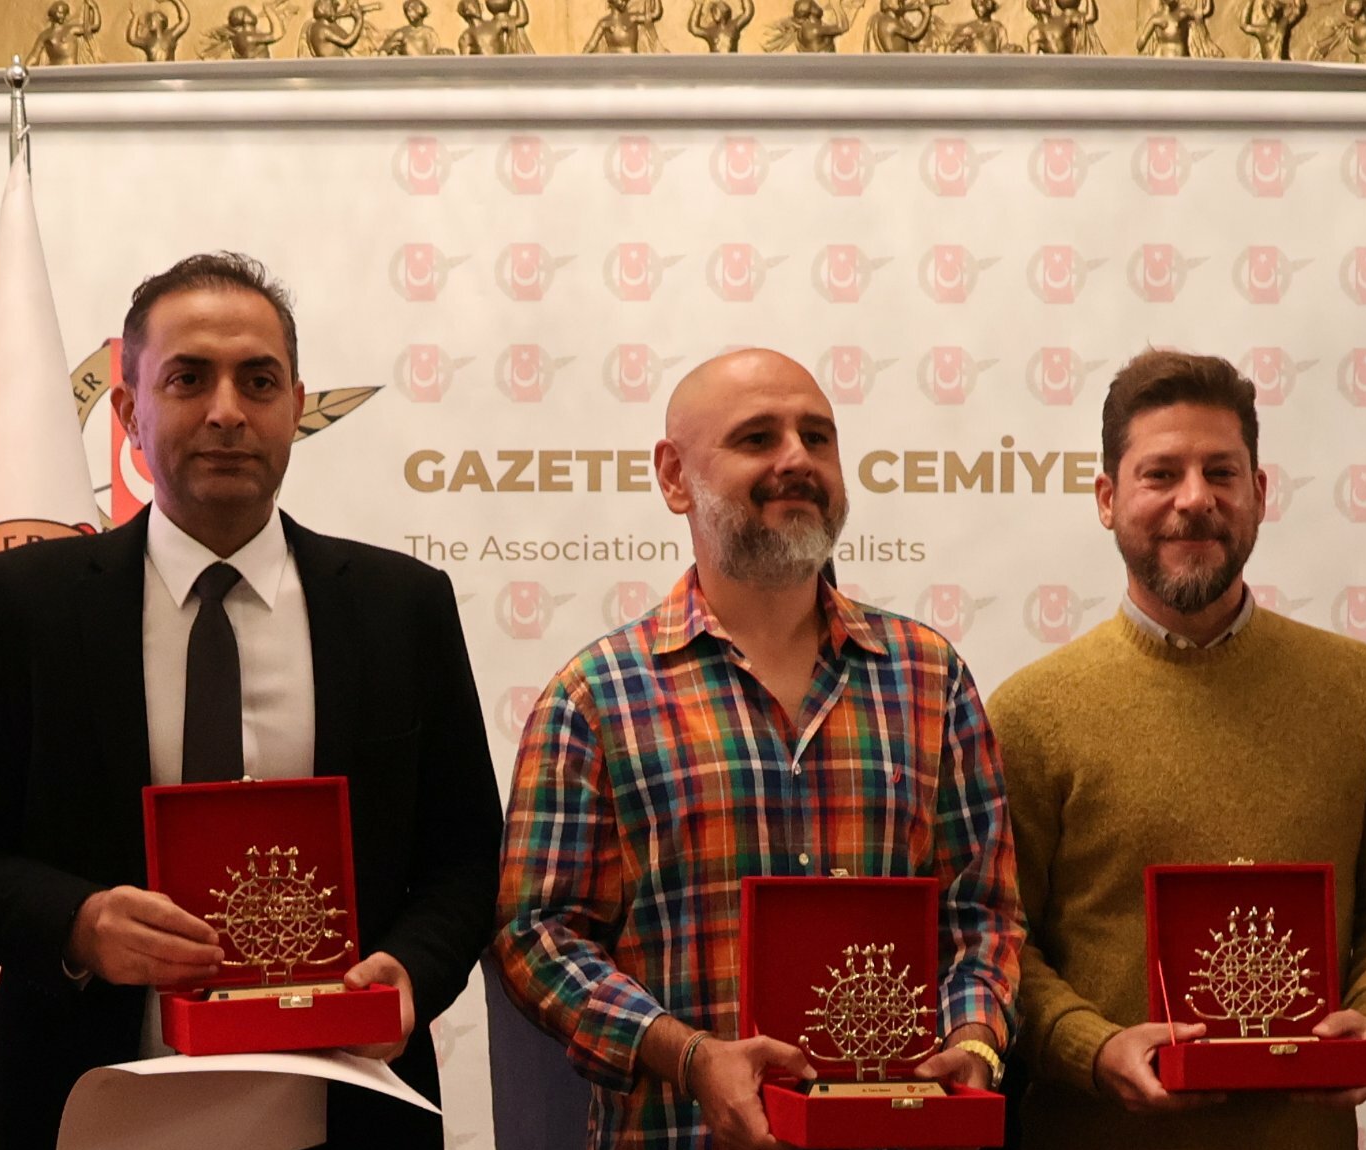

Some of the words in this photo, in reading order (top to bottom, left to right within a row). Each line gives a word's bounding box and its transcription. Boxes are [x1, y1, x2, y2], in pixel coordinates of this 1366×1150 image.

[404, 448, 652, 493] GAZETE
[858, 435, 1104, 494] CEMİYE
[404, 534, 468, 561] The
[479, 533, 679, 561] Association
[837, 534, 926, 562] alists
